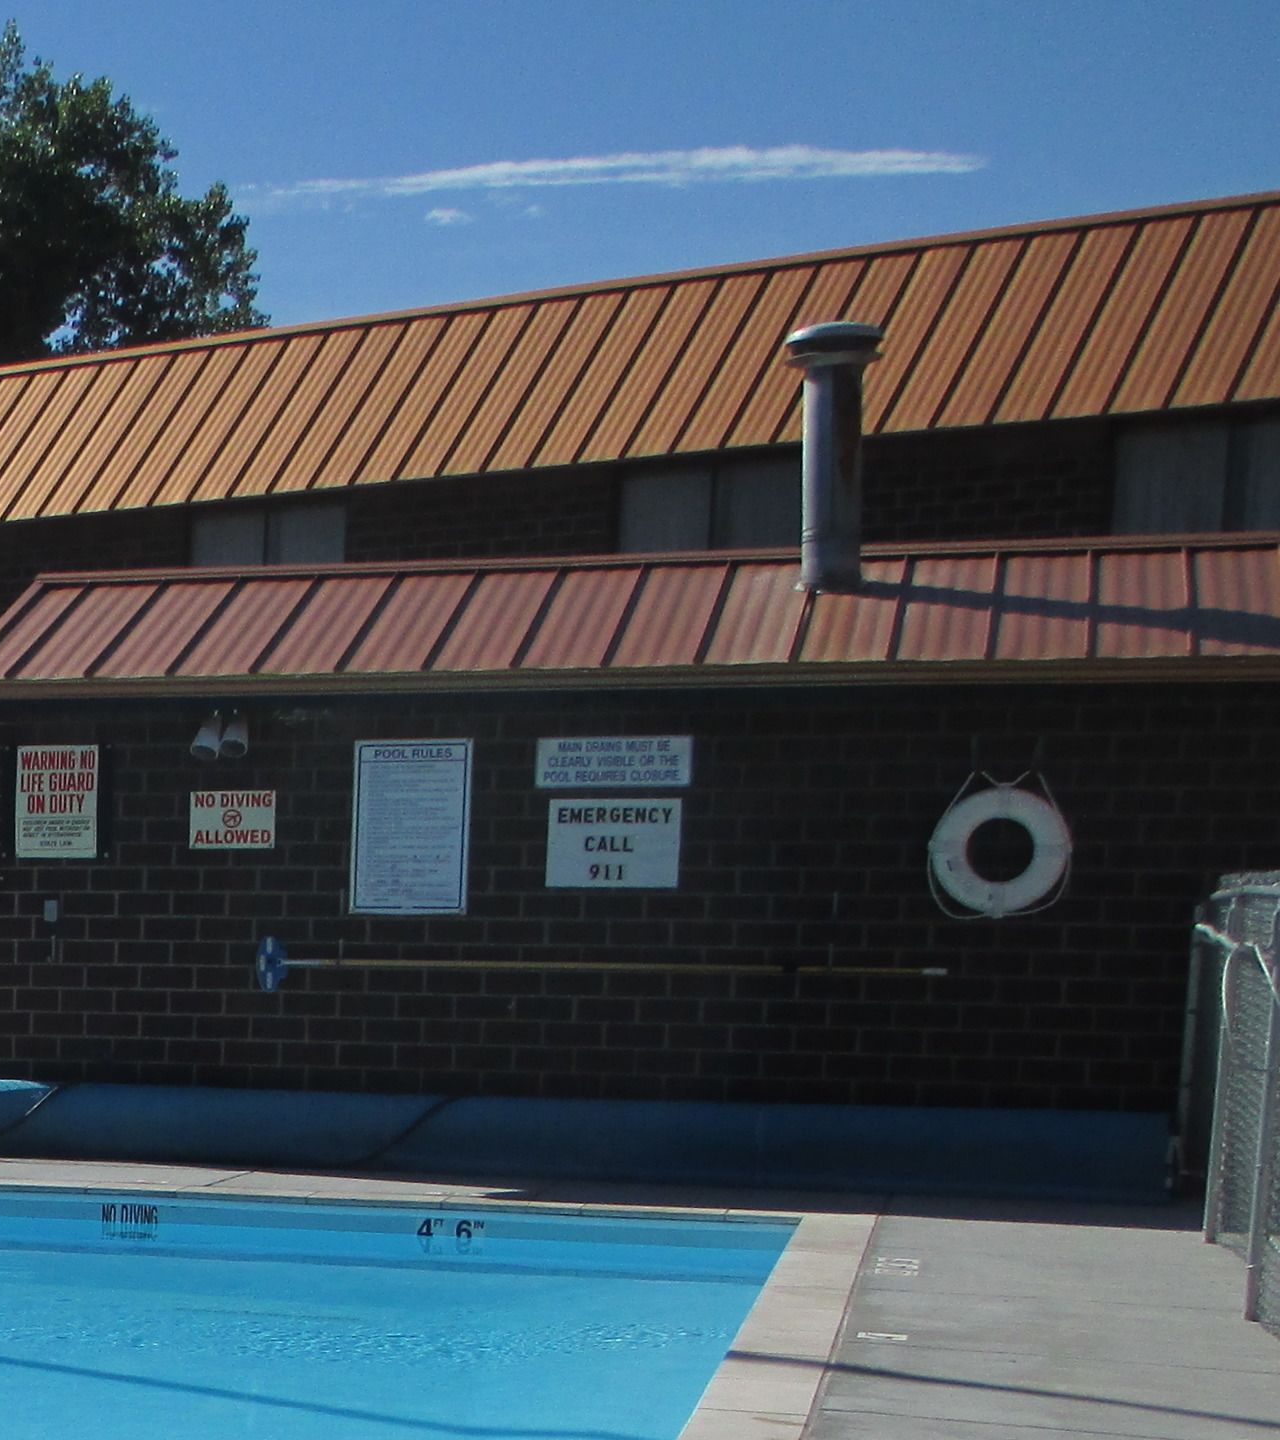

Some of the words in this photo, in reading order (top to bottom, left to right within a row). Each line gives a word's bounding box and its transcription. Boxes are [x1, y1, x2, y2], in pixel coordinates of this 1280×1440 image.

[374, 749, 408, 759] POOL
[412, 748, 452, 759] RULES
[558, 741, 582, 752] MAIN
[585, 741, 622, 752] DRAINS
[626, 741, 654, 751] MUST
[657, 740, 671, 751] BE
[21, 750, 75, 770] WARNING
[80, 750, 95, 769] NO
[548, 756, 592, 768] CLEARLY
[597, 755, 635, 767] VISIBLE
[640, 755, 654, 766] OR
[659, 755, 680, 766] THE
[20, 773, 44, 792] LIFE
[49, 772, 94, 792] GUARD
[544, 771, 571, 782] POOL
[575, 770, 626, 782] REQUIRES
[27, 795, 45, 814] ON
[49, 794, 85, 814] DUTY
[195, 793, 215, 808] NO
[220, 792, 273, 808] DIVING
[557, 807, 673, 824] EMERGENCY
[194, 829, 271, 844] ALLOWED
[584, 836, 634, 852] CALL
[589, 864, 624, 881] 911
[102, 1203, 116, 1223] NO
[121, 1203, 158, 1225] DIVING
